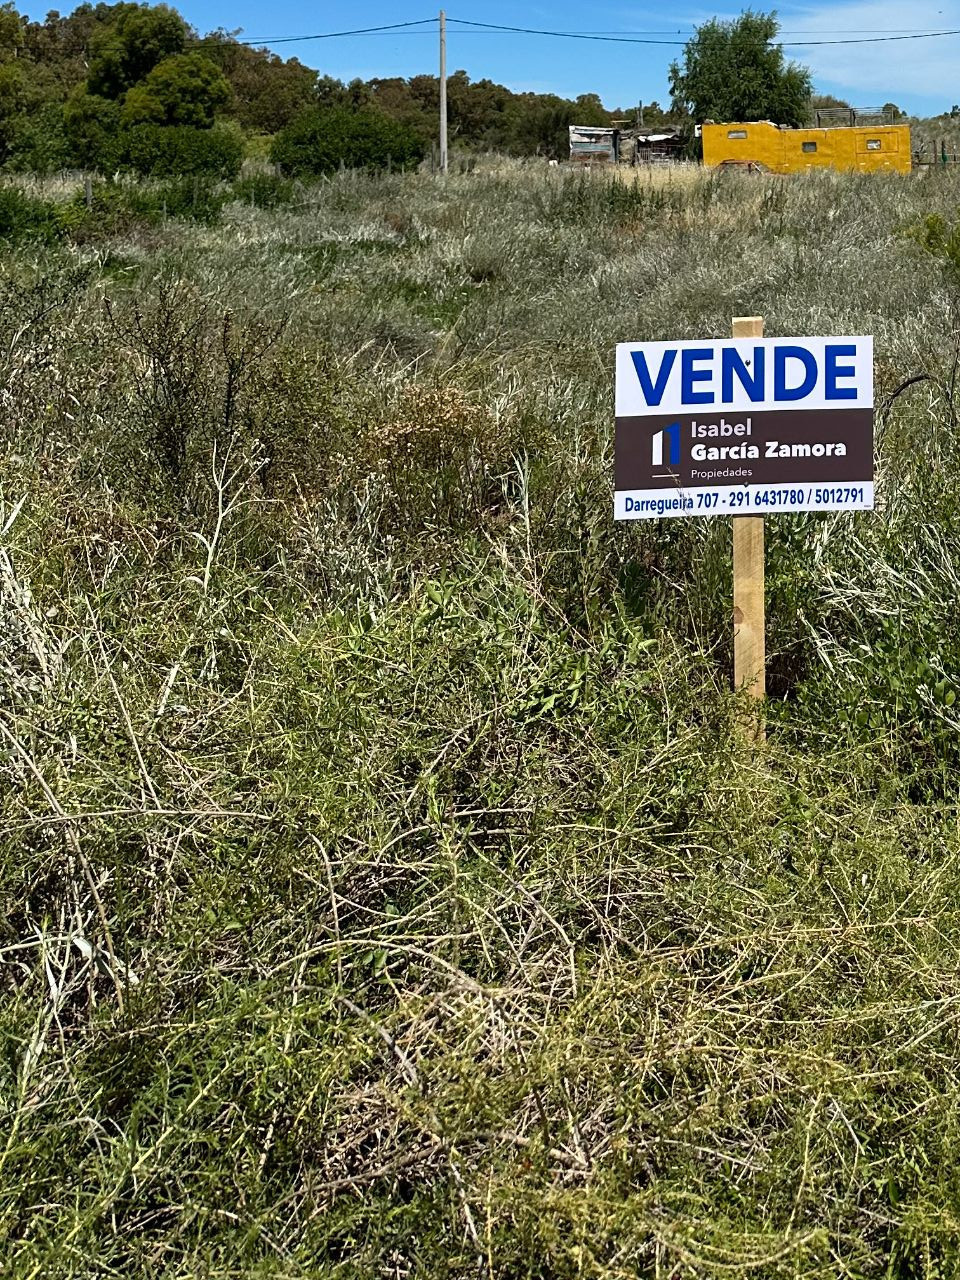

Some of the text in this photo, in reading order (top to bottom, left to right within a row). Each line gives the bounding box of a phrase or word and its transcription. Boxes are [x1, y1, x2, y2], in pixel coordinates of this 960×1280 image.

[630, 344, 858, 407] VENDE
[691, 418, 752, 438] Isabel
[691, 441, 847, 461] García Zamora
[691, 468, 753, 480] Propiedades
[625, 493, 694, 512] Darregueira
[697, 493, 719, 509] 707
[729, 492, 750, 507] 291
[754, 489, 804, 506] 6431780
[807, 489, 813, 505] /
[815, 488, 864, 504] 5012791
